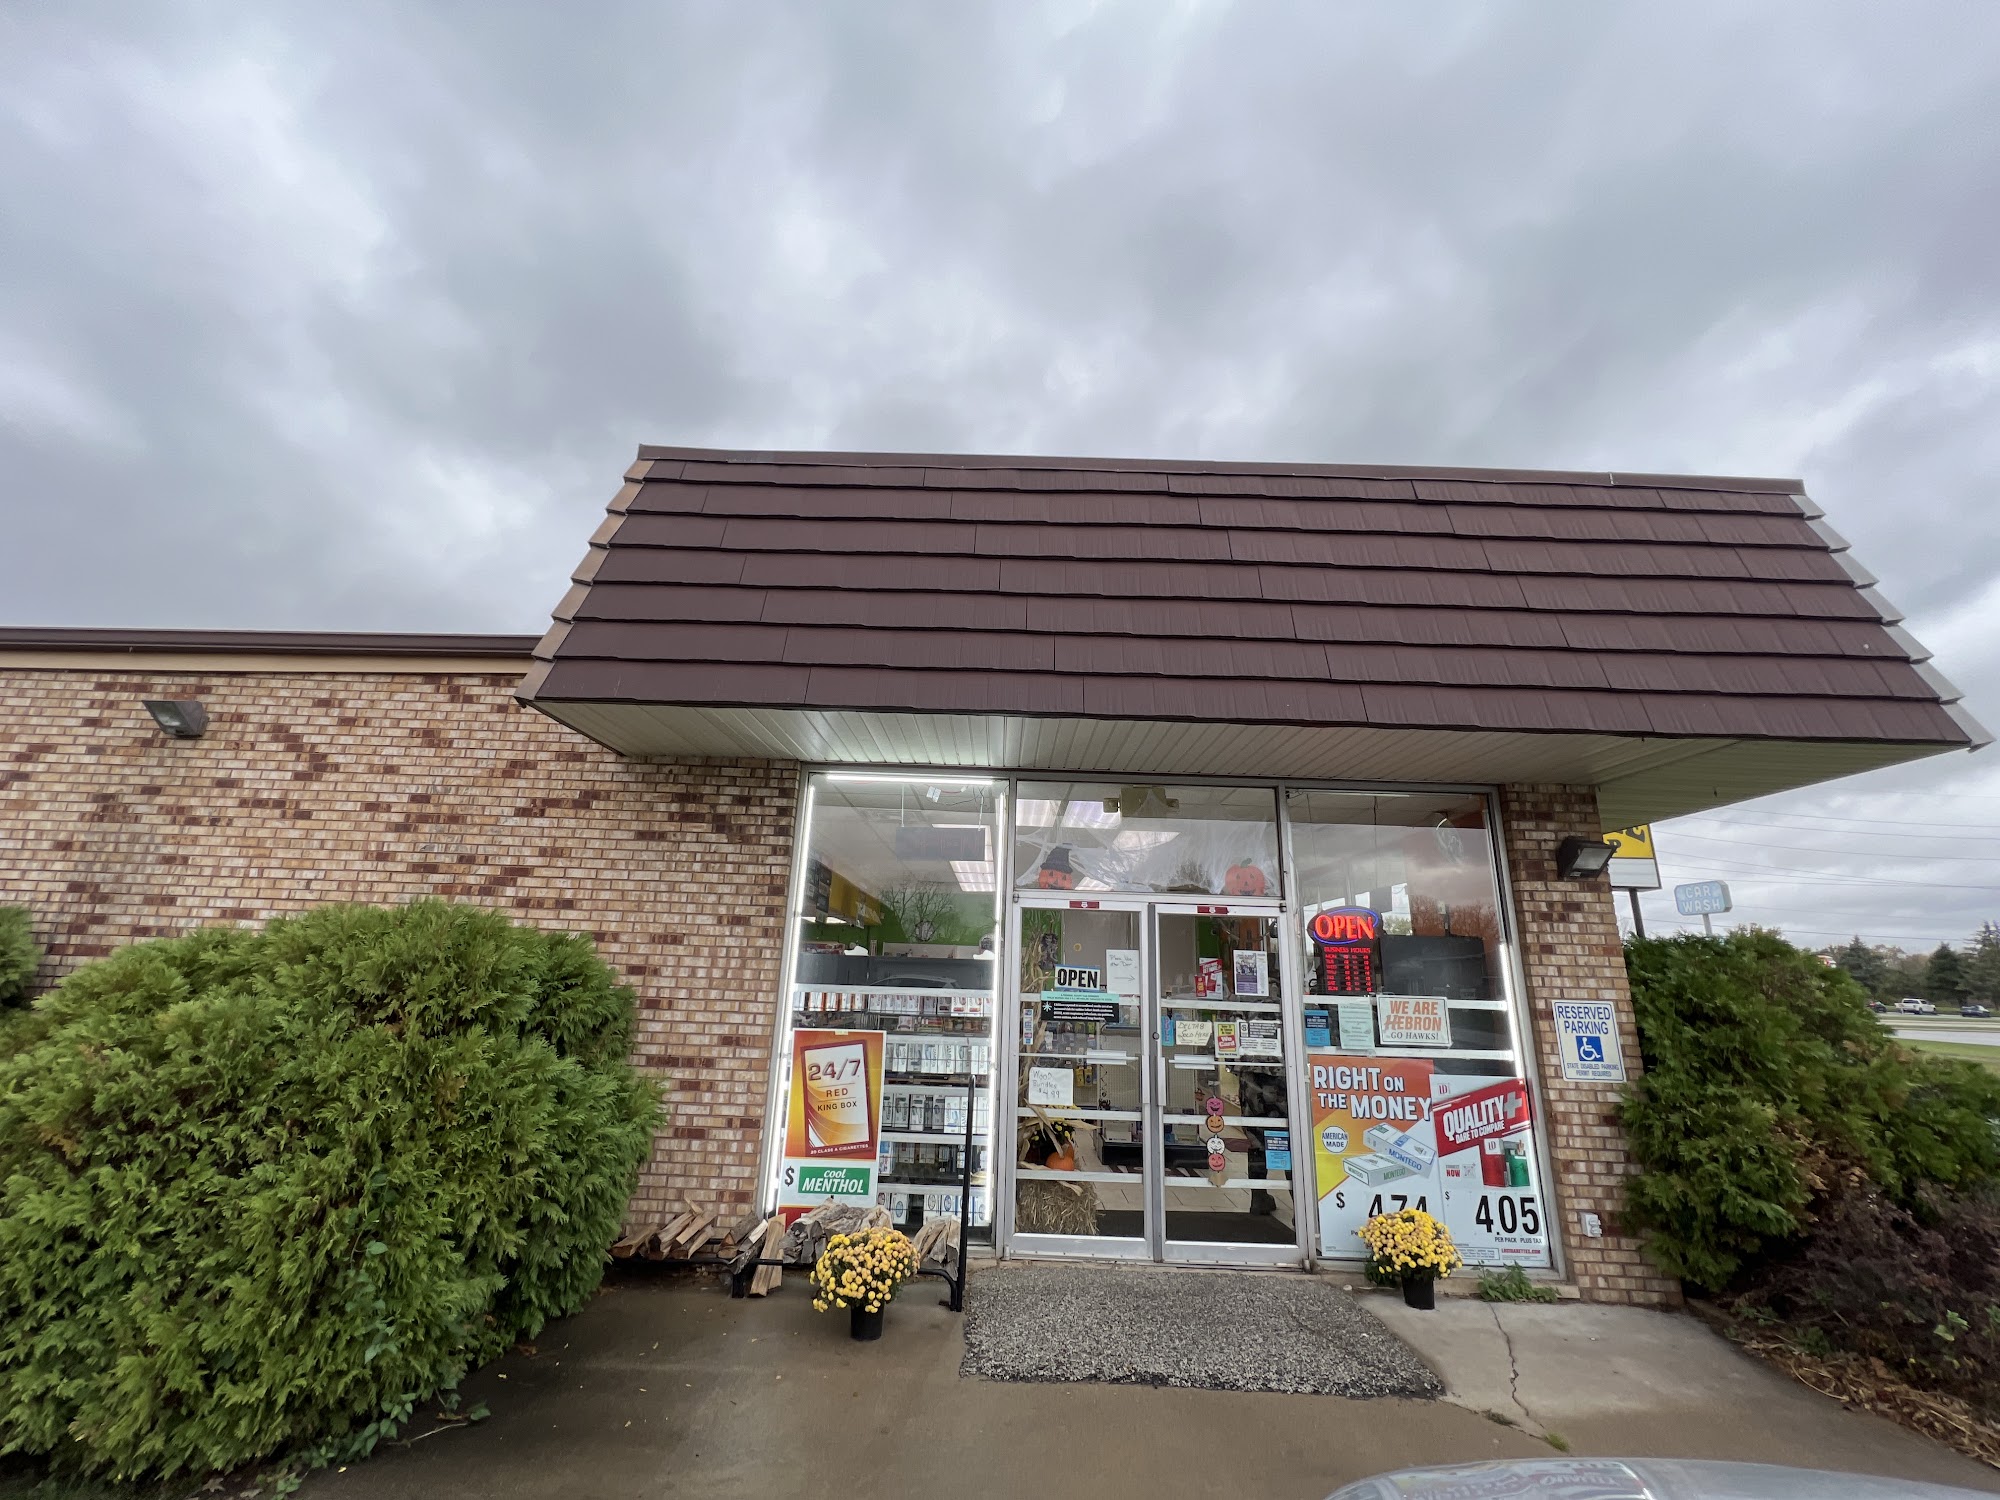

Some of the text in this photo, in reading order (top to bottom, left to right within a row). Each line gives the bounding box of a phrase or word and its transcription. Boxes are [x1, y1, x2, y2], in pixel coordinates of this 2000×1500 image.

[1685, 885, 1711, 899] CAR
[1682, 899, 1721, 914] WASH
[1315, 915, 1374, 939] OPEN
[1057, 968, 1098, 988] OPEN
[1390, 1000, 1438, 1015] WE ARE
[1557, 1005, 1611, 1020] RESERVED
[1384, 1015, 1442, 1031] HEBRON
[1564, 1020, 1609, 1035] PARKING
[1406, 1032, 1439, 1040] HAWKS!
[808, 1058, 861, 1081] 24/7
[1313, 1065, 1405, 1092] RIGHT ON
[826, 1088, 849, 1098] RED
[817, 1100, 858, 1112] KING BOX
[1317, 1092, 1432, 1121] THE MONEY
[1322, 1132, 1348, 1140] AMERICAN
[1455, 1120, 1505, 1144] DARE TO COMPARE
[839, 1143, 869, 1152] CIGARETTES
[1388, 1148, 1422, 1171] MONTEGO
[784, 1165, 795, 1187] $
[823, 1168, 847, 1178] cool
[1383, 1167, 1406, 1181] MONTEGO
[1446, 1169, 1461, 1177] NOW
[801, 1177, 864, 1193] MENTHOL
[1336, 1190, 1346, 1210] $
[1445, 1190, 1451, 1201] $
